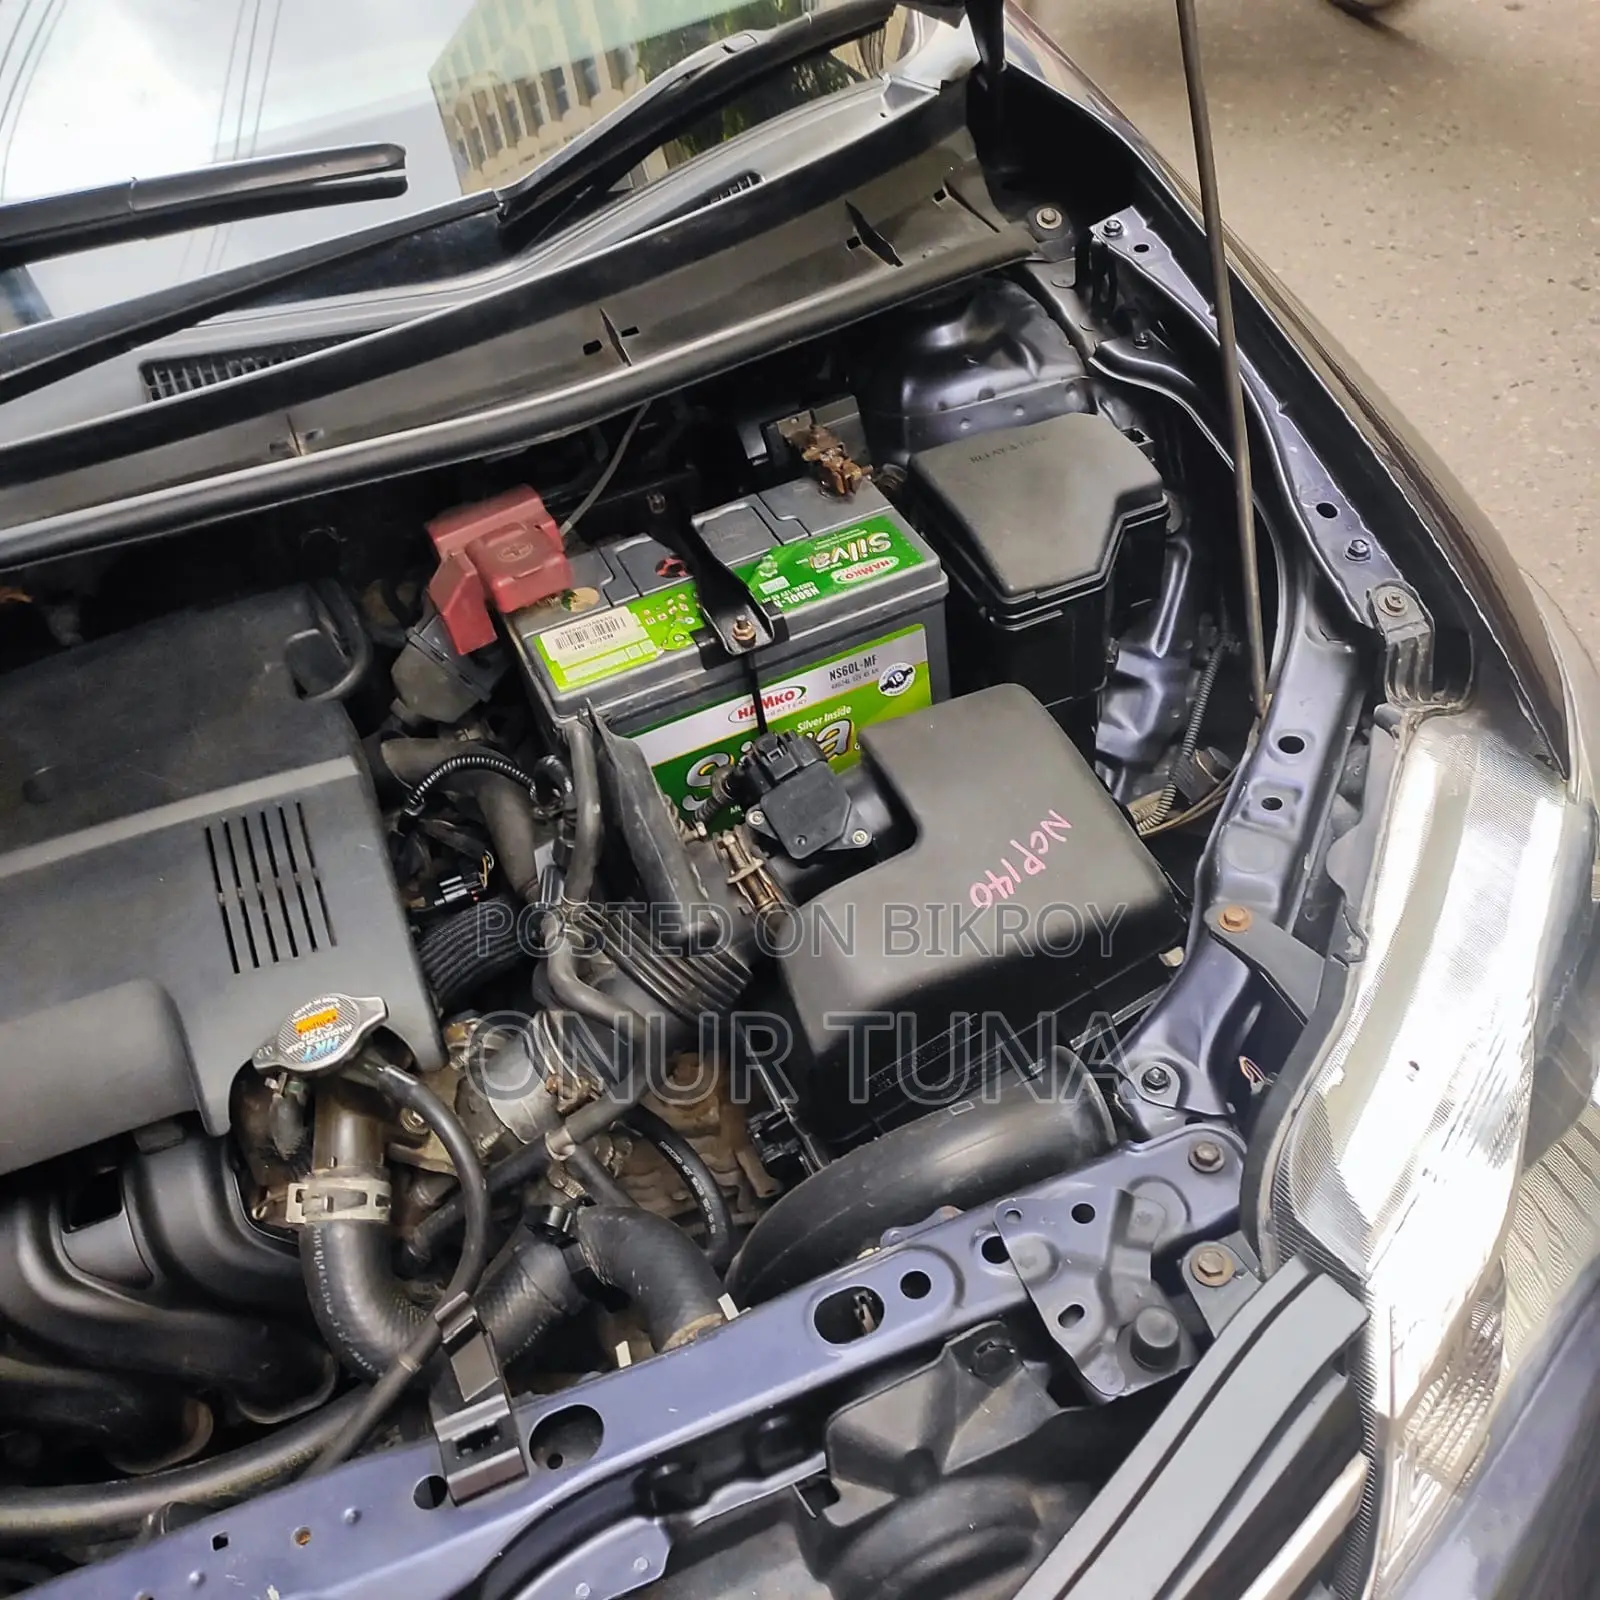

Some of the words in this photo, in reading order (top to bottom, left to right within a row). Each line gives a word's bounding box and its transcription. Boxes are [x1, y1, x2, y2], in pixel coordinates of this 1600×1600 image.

[809, 532, 892, 569] Silva
[845, 559, 890, 580] HAMKO
[829, 654, 878, 681] NS60L-MF
[889, 671, 904, 685] 18
[797, 714, 824, 733] Silver
[824, 704, 852, 723] Inside
